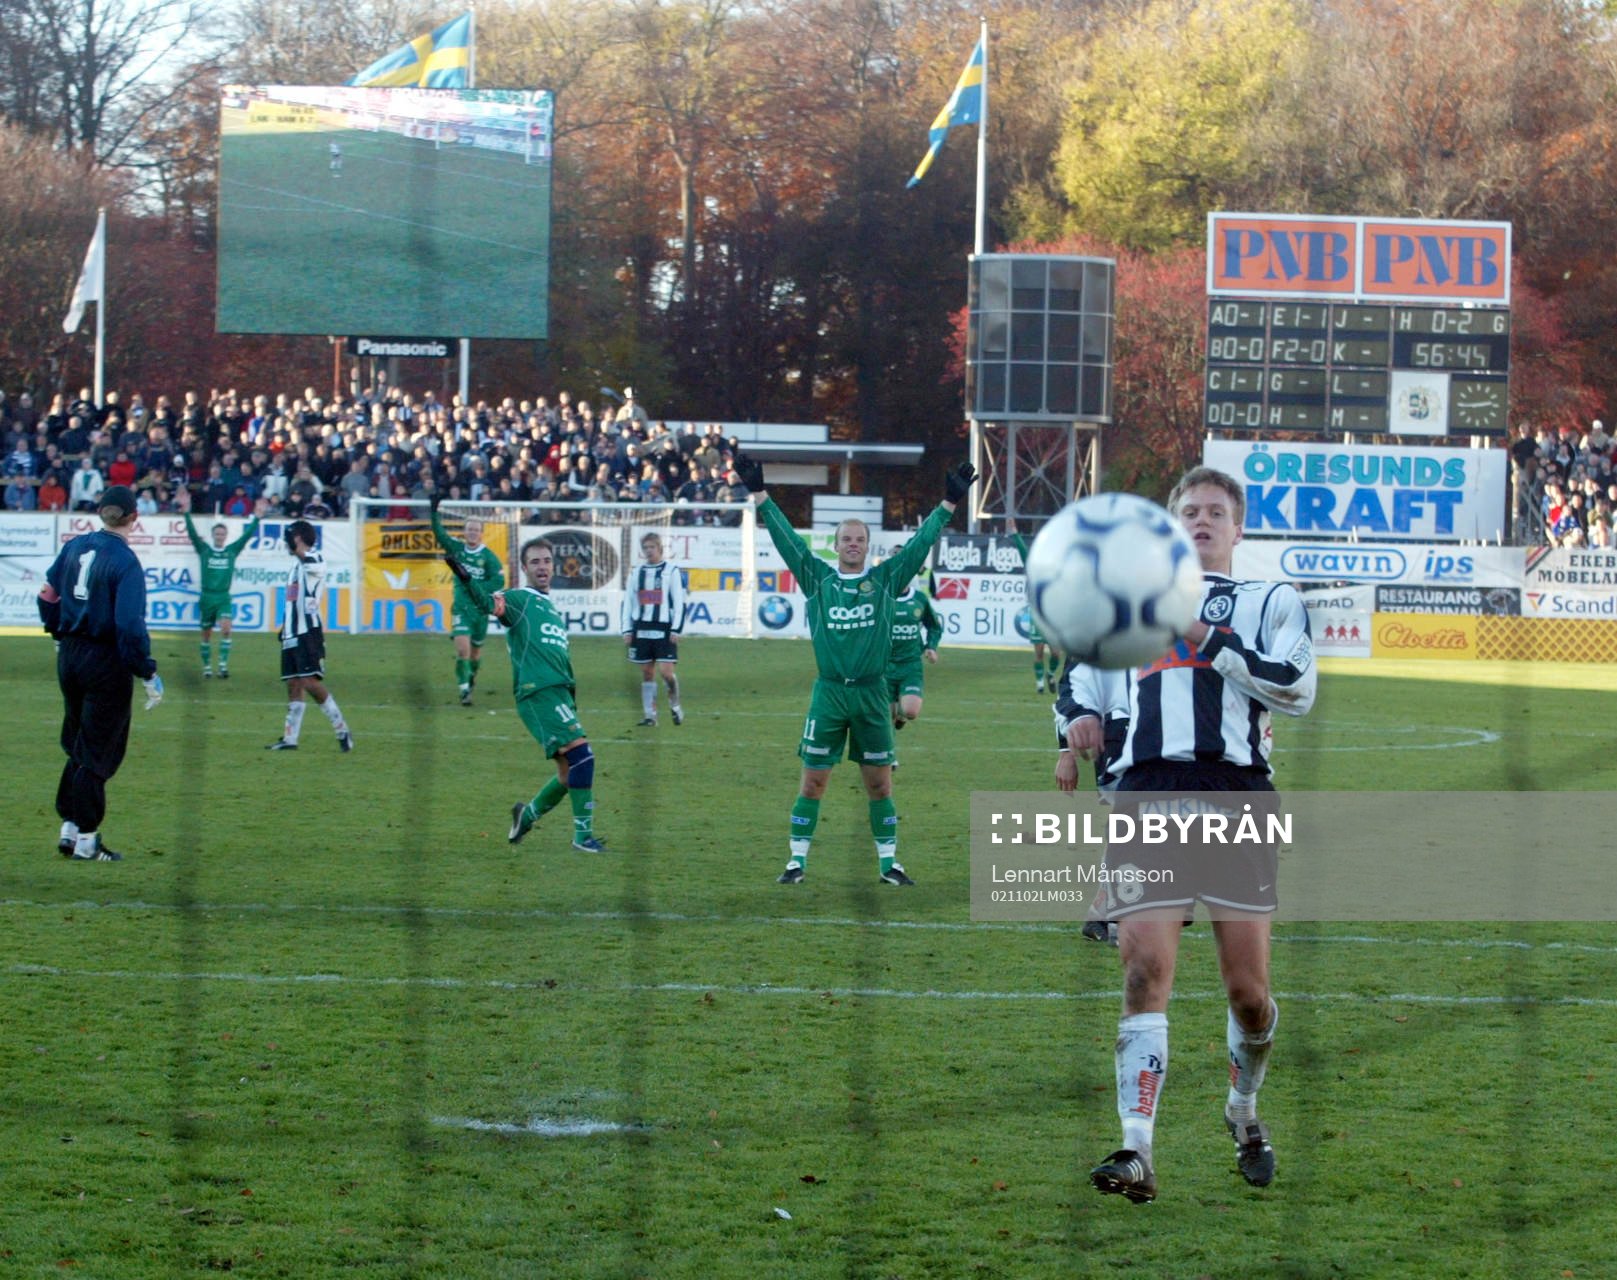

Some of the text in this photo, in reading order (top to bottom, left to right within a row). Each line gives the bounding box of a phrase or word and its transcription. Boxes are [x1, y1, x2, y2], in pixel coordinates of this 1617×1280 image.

[1220, 228, 1349, 282] PNB
[1371, 232, 1499, 287] PNB
[357, 338, 447, 356] Panasonic
[1243, 444, 1465, 488] ÖRESUNDS
[1244, 484, 1463, 534] KRAFT
[1294, 551, 1392, 573] wavin
[1424, 550, 1474, 579] ips
[1569, 554, 1617, 569] EKEB
[73, 549, 96, 600] 1
[980, 579, 1027, 593] BYGG
[1380, 588, 1482, 605] RESTAURANG
[1552, 595, 1617, 614] Scand
[828, 603, 875, 621] coop
[1378, 623, 1469, 650] Cloetta
